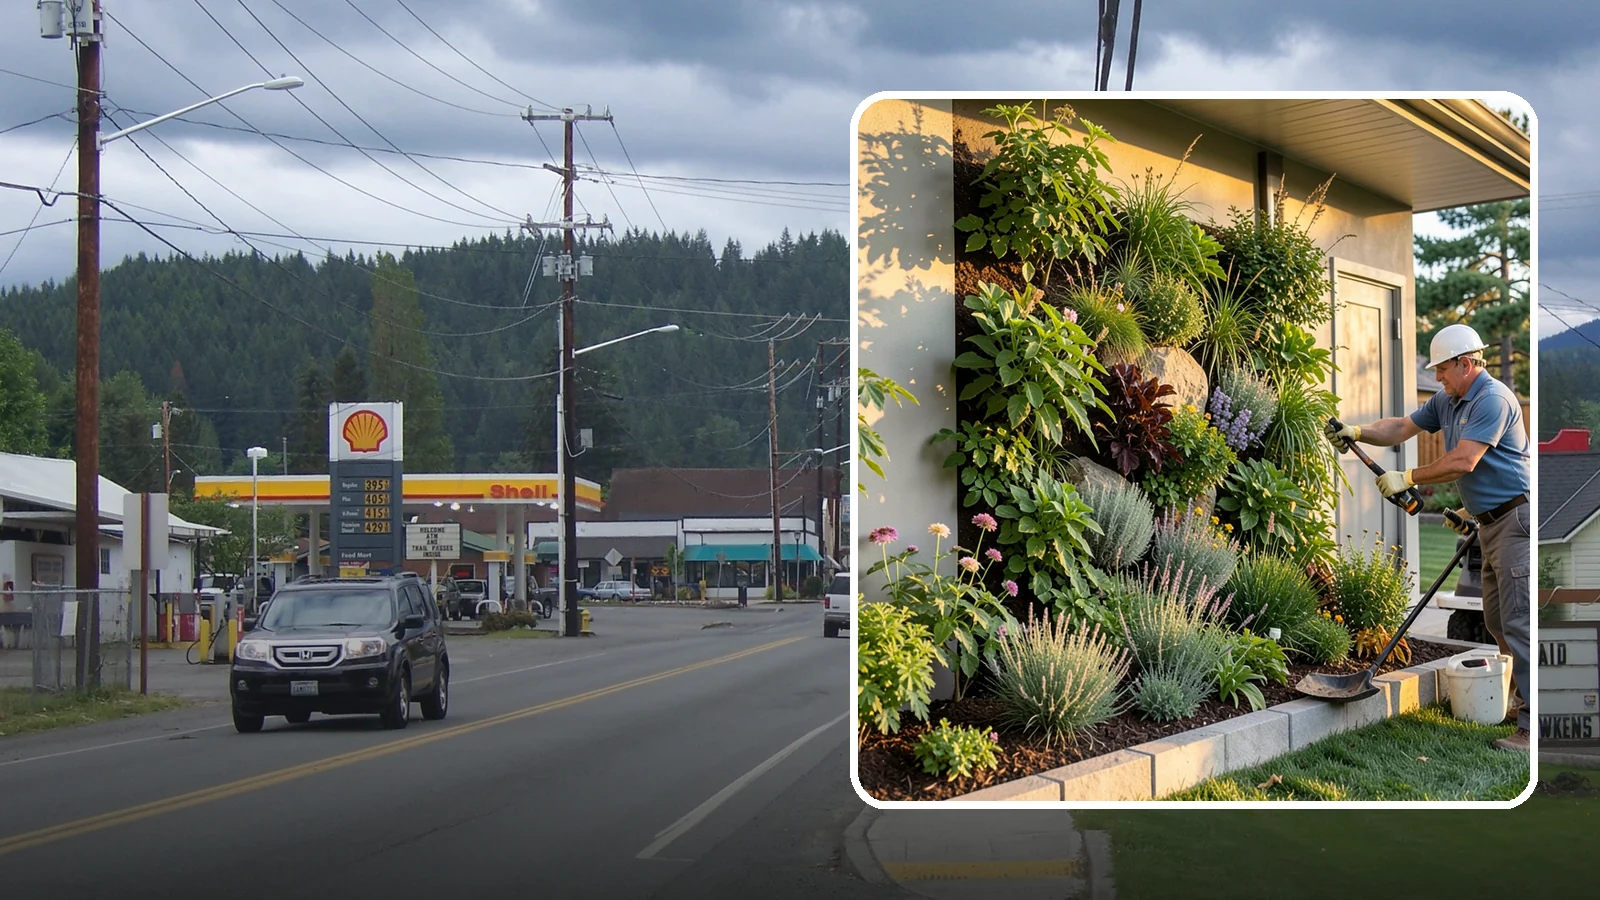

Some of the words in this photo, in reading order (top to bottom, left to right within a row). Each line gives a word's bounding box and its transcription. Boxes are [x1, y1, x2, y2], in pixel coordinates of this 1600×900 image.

[366, 480, 383, 490] 395
[490, 484, 547, 499] Shell
[366, 494, 383, 504] 405
[366, 507, 383, 518] 415
[366, 522, 383, 532] 429
